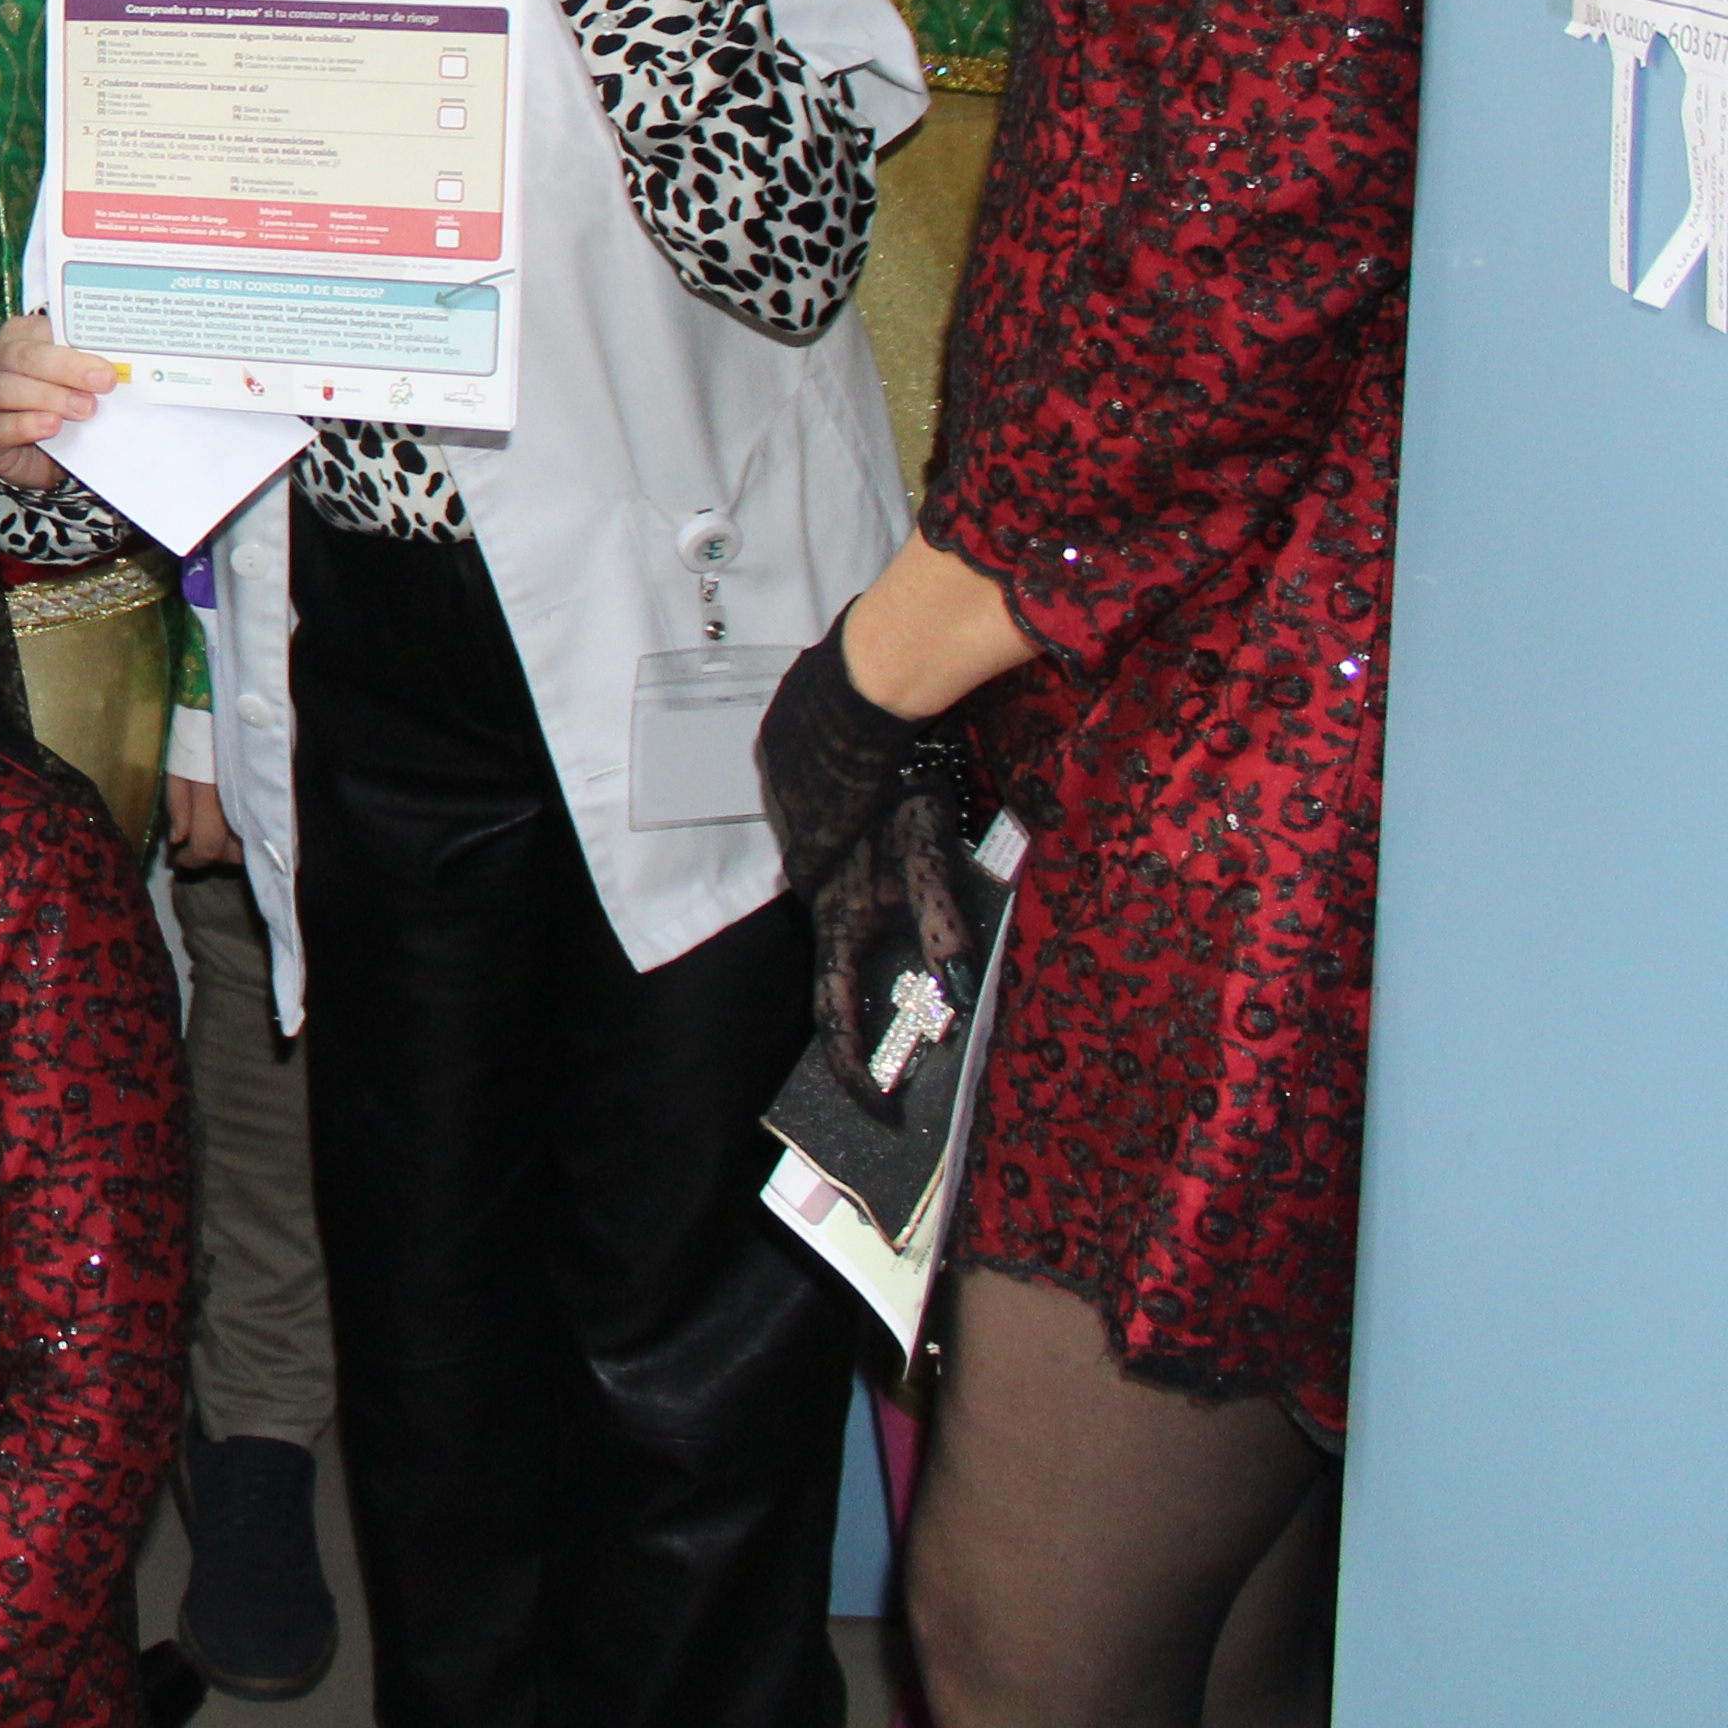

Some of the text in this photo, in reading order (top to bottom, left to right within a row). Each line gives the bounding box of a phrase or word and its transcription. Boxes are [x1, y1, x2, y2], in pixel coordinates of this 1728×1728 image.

[125, 1, 187, 18] Comprueba
[188, 6, 203, 16] en
[204, 4, 225, 17] tres
[264, 6, 272, 18] si
[275, 7, 286, 19] tu
[288, 9, 336, 20] consumo
[338, 9, 370, 24] puede
[373, 12, 388, 22] ser
[391, 11, 404, 23] de
[406, 11, 438, 26] riesgo
[1669, 22, 1700, 56] 603
[170, 273, 383, 299] ¿QUÉ ES UN CONSUMO DE RIESGO?
